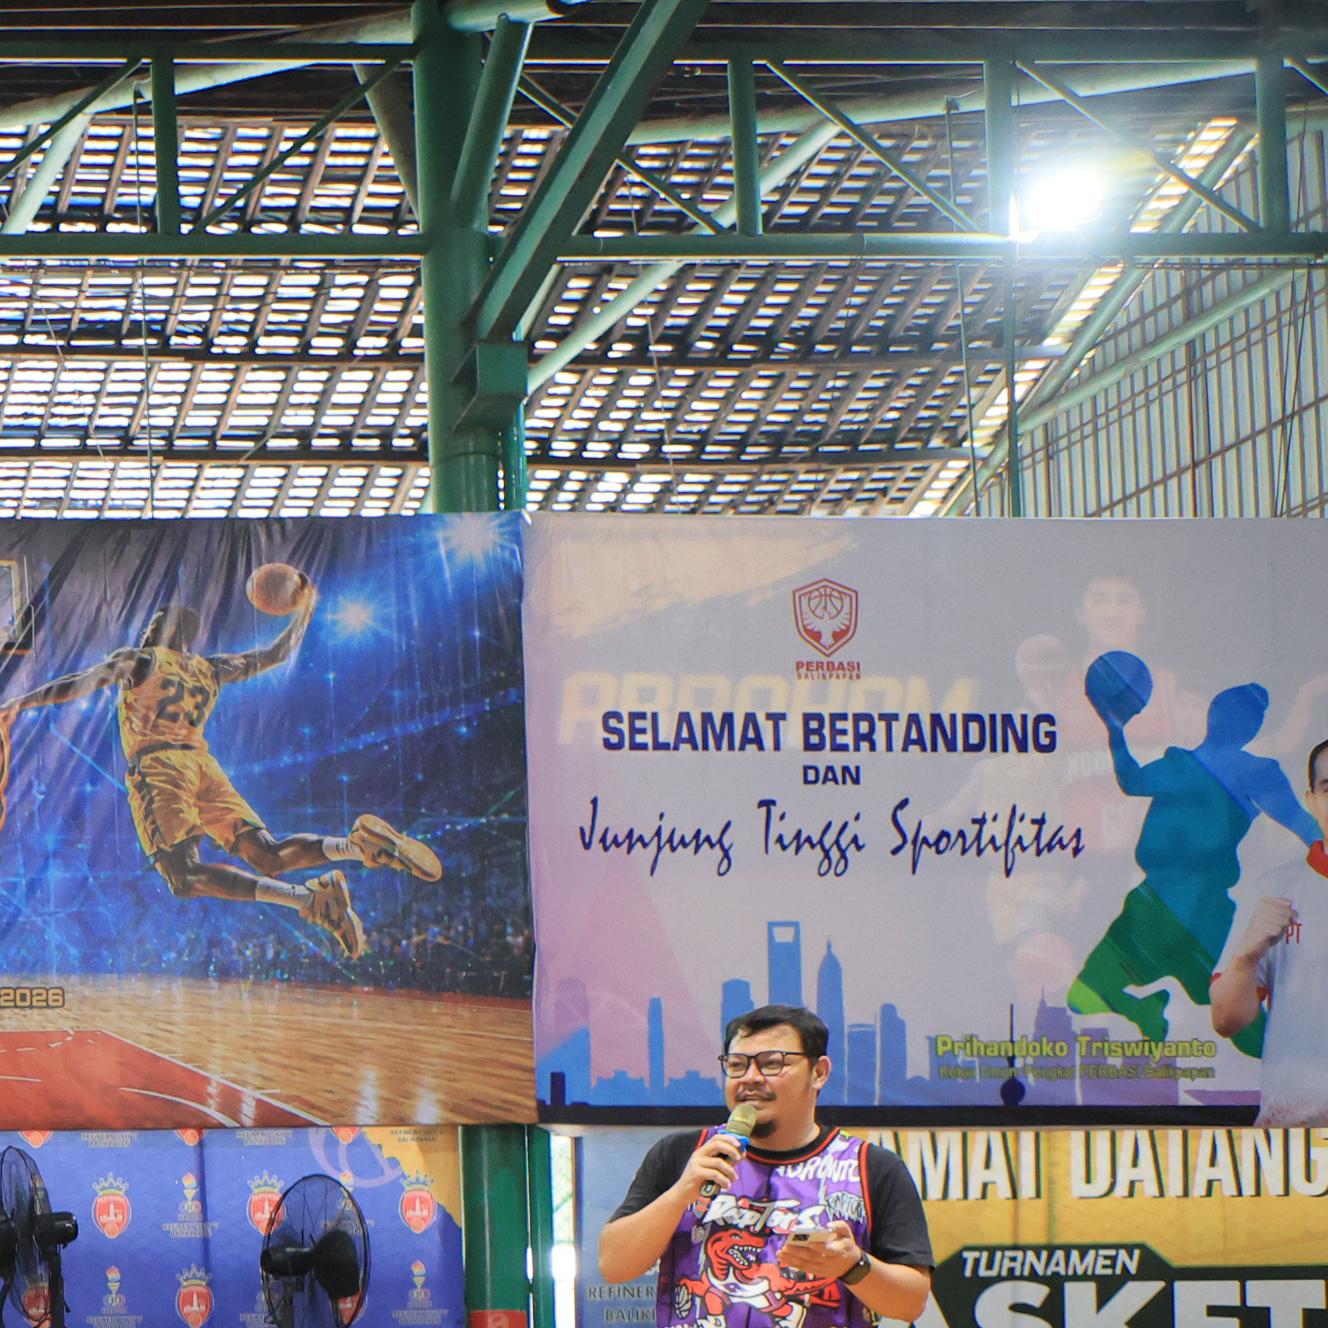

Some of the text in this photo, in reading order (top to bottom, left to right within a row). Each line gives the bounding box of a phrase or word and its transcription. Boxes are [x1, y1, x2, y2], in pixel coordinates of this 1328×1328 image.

[602, 711, 1057, 754] SELAMAT BERTANDING
[802, 765, 862, 786] DAN
[579, 797, 1085, 878] Junjung Tinggi Sportifitas
[0, 988, 65, 1008] 2026
[936, 1035, 1218, 1062] Prihandoko Triswiyanto
[961, 1248, 1141, 1279] TURNAMEN
[587, 1285, 656, 1300] REFINER
